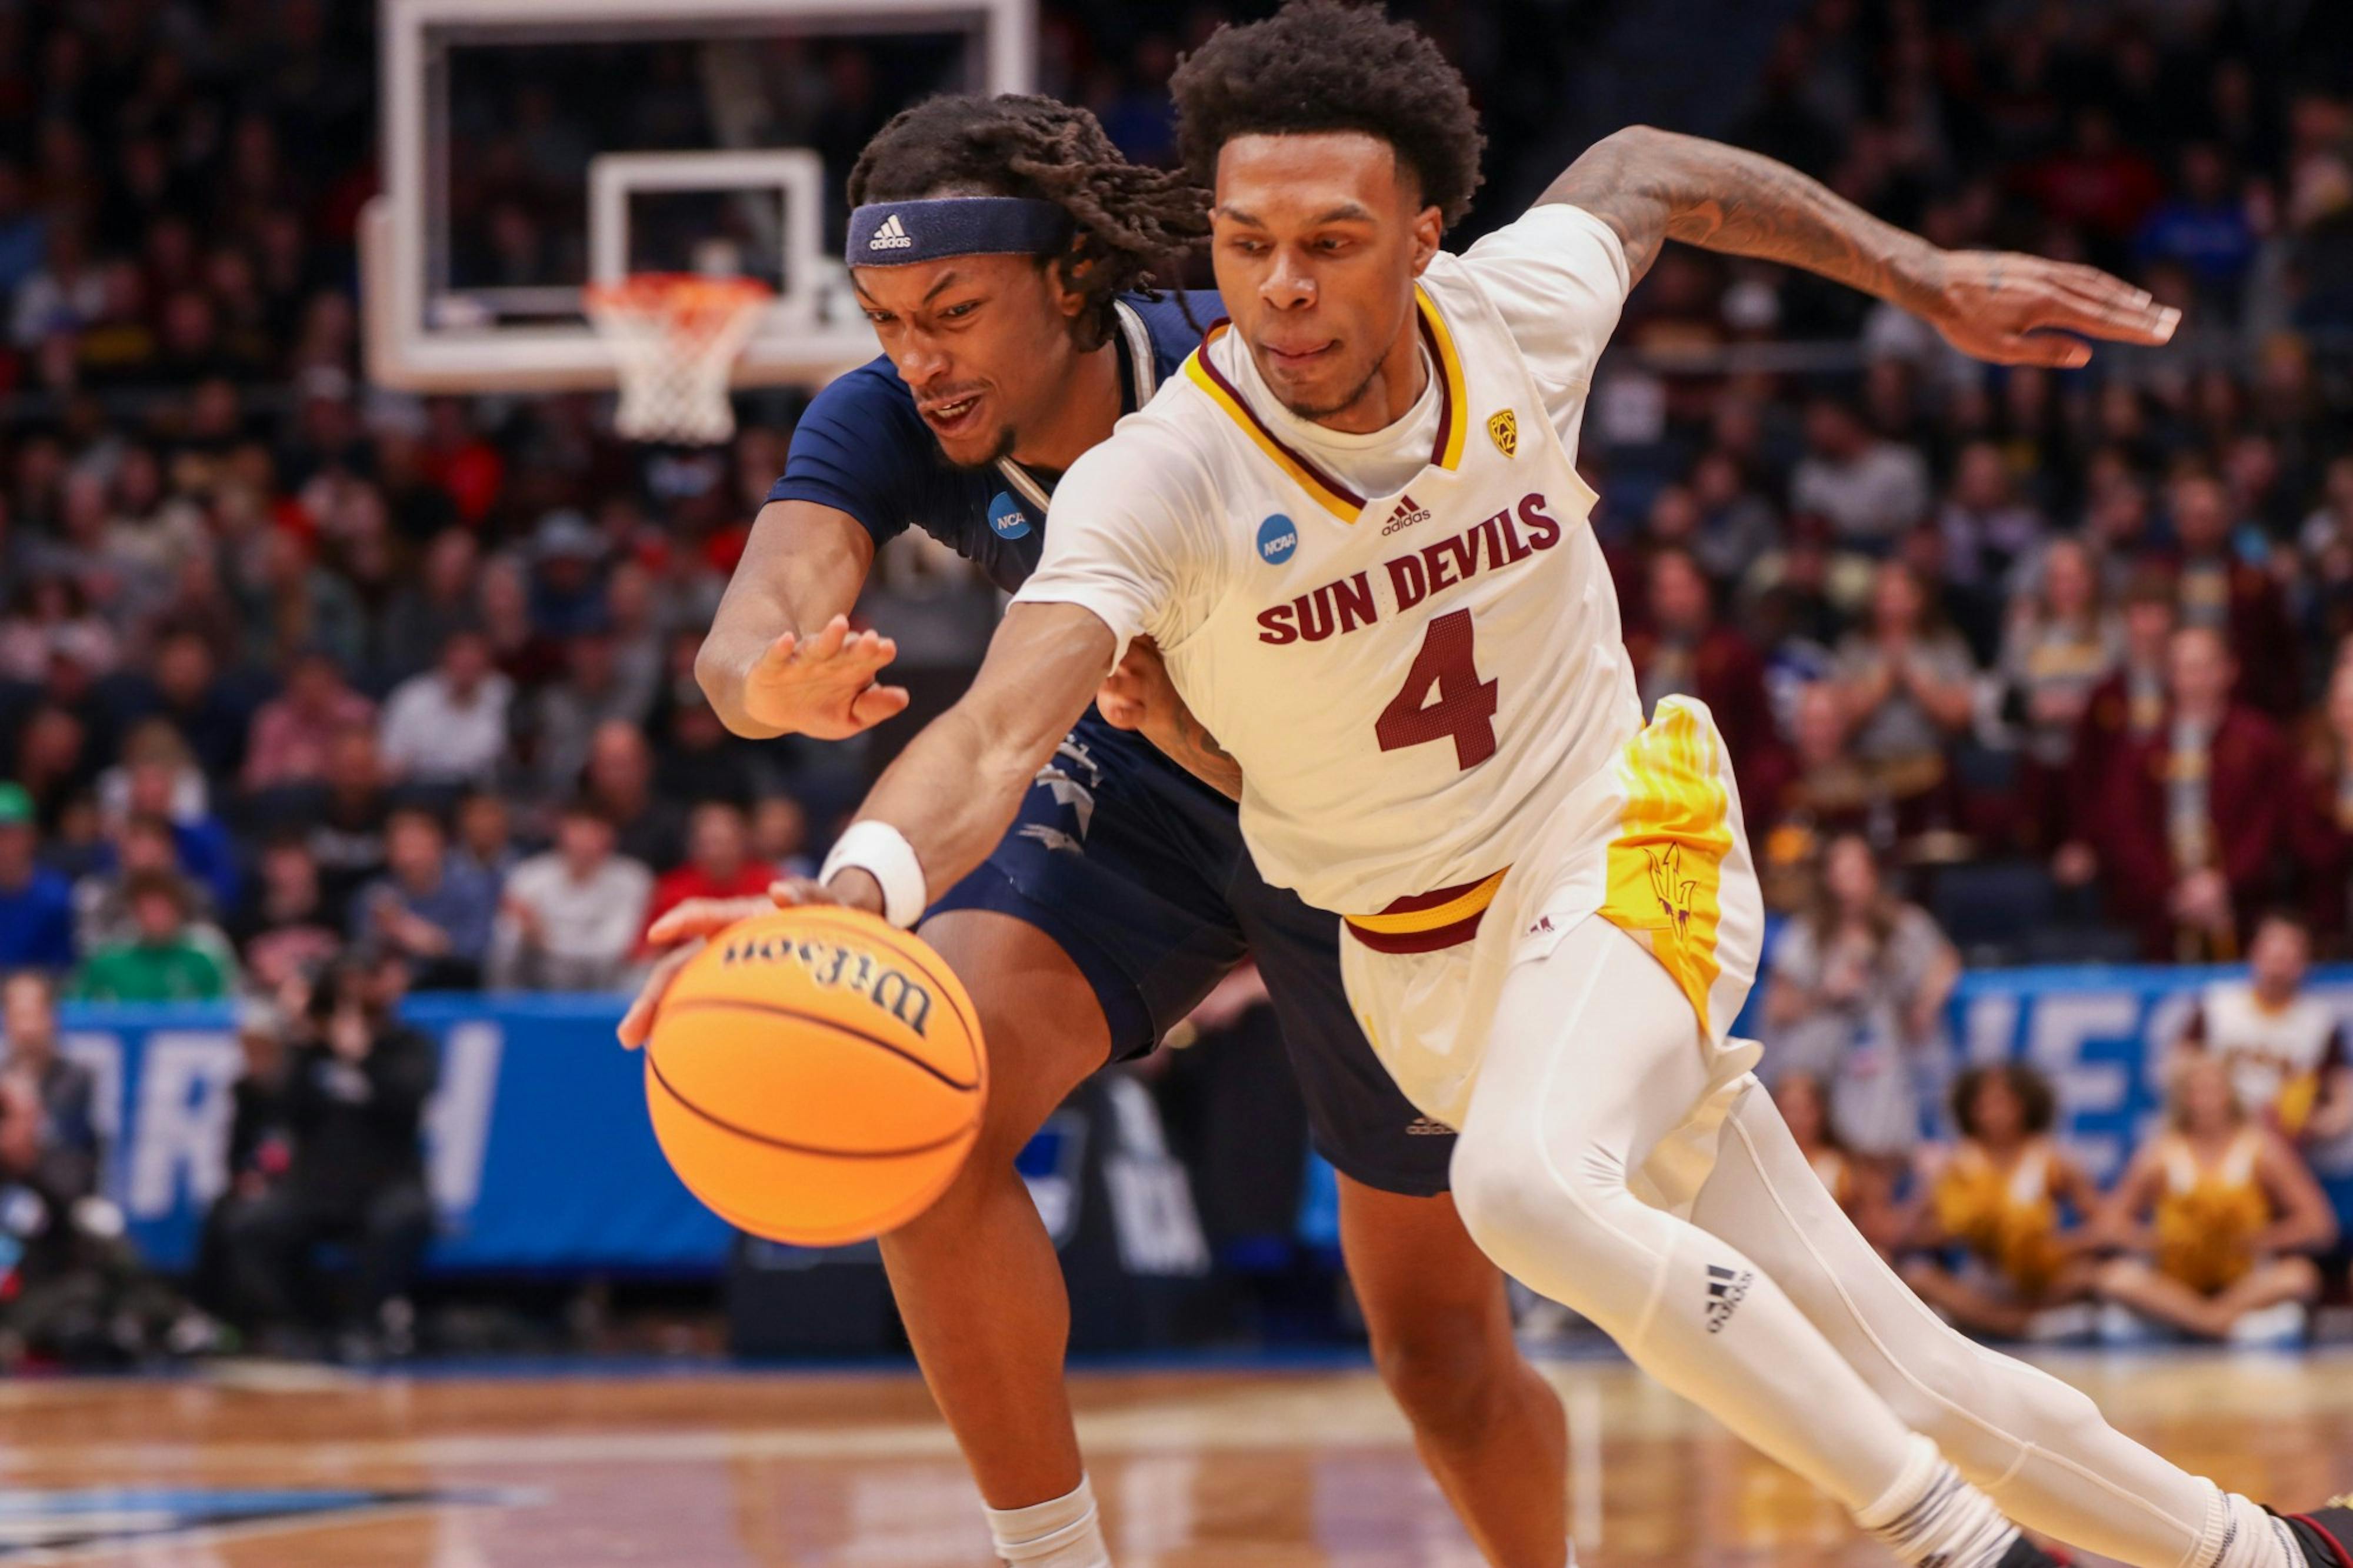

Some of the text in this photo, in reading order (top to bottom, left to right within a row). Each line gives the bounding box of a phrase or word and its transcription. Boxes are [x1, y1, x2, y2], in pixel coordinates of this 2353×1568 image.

[870, 235, 912, 251] adidas
[1489, 412, 1515, 442] PAC
[997, 512, 1026, 530] NCA
[1382, 510, 1431, 536] adidas
[1264, 532, 1296, 556] NCAA
[1257, 493, 1561, 645] SUN DEVILS
[1375, 608, 1498, 771] 4
[724, 939, 932, 1039] Wilson
[1706, 1270, 1754, 1334] adidas
